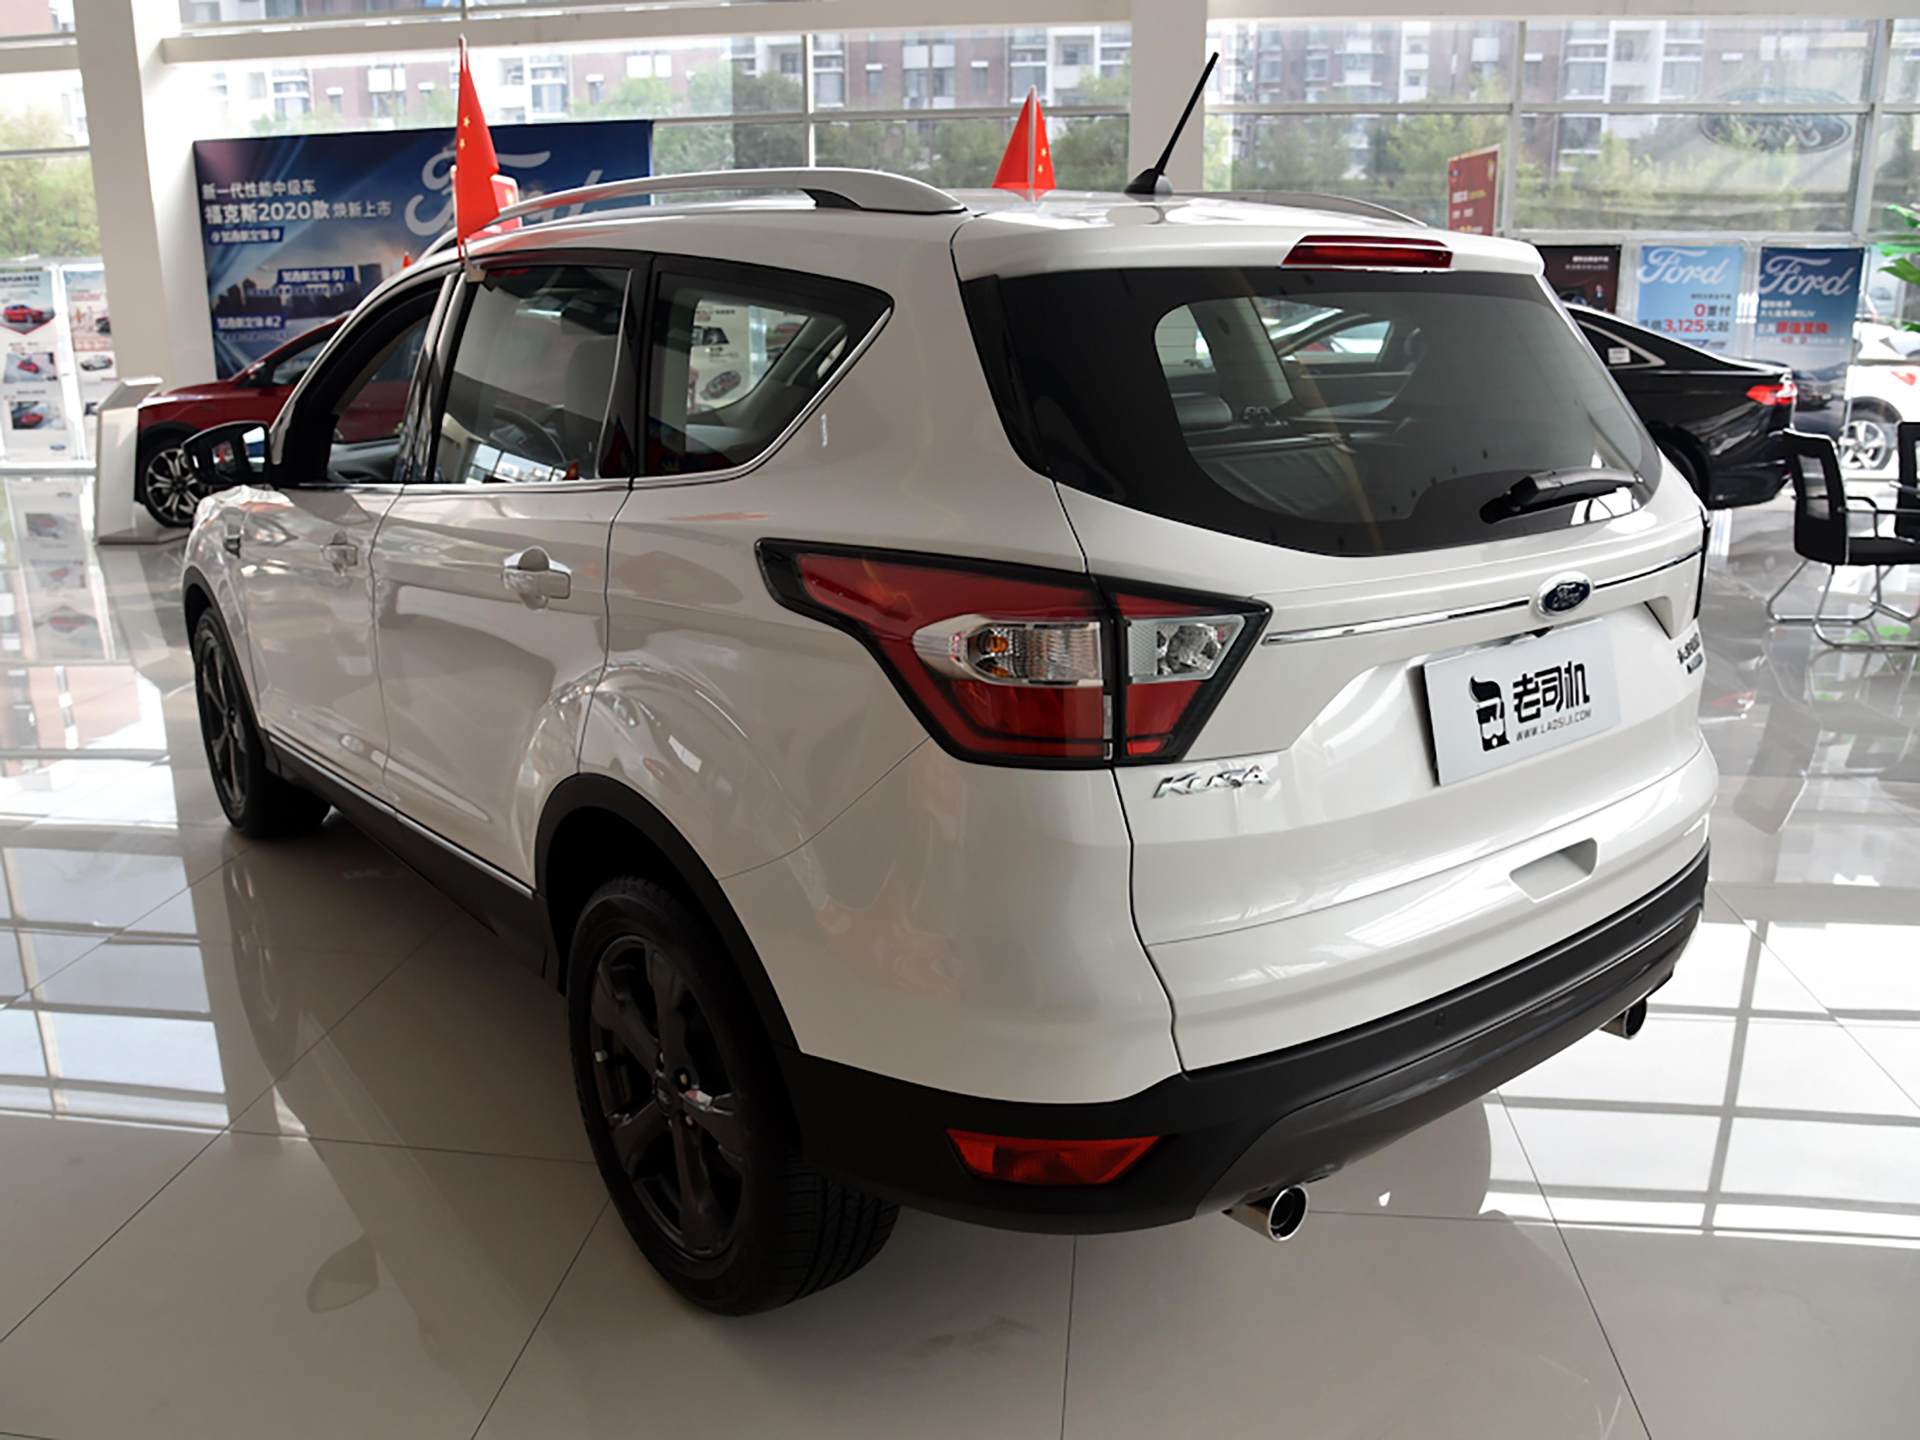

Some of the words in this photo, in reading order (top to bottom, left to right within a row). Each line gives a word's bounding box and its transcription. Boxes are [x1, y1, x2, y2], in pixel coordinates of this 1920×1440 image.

[204, 200, 330, 225] 福克斯2020款
[1636, 247, 1730, 285] Ford
[1758, 255, 1855, 296] Ford
[1513, 660, 1591, 724] 老司机
